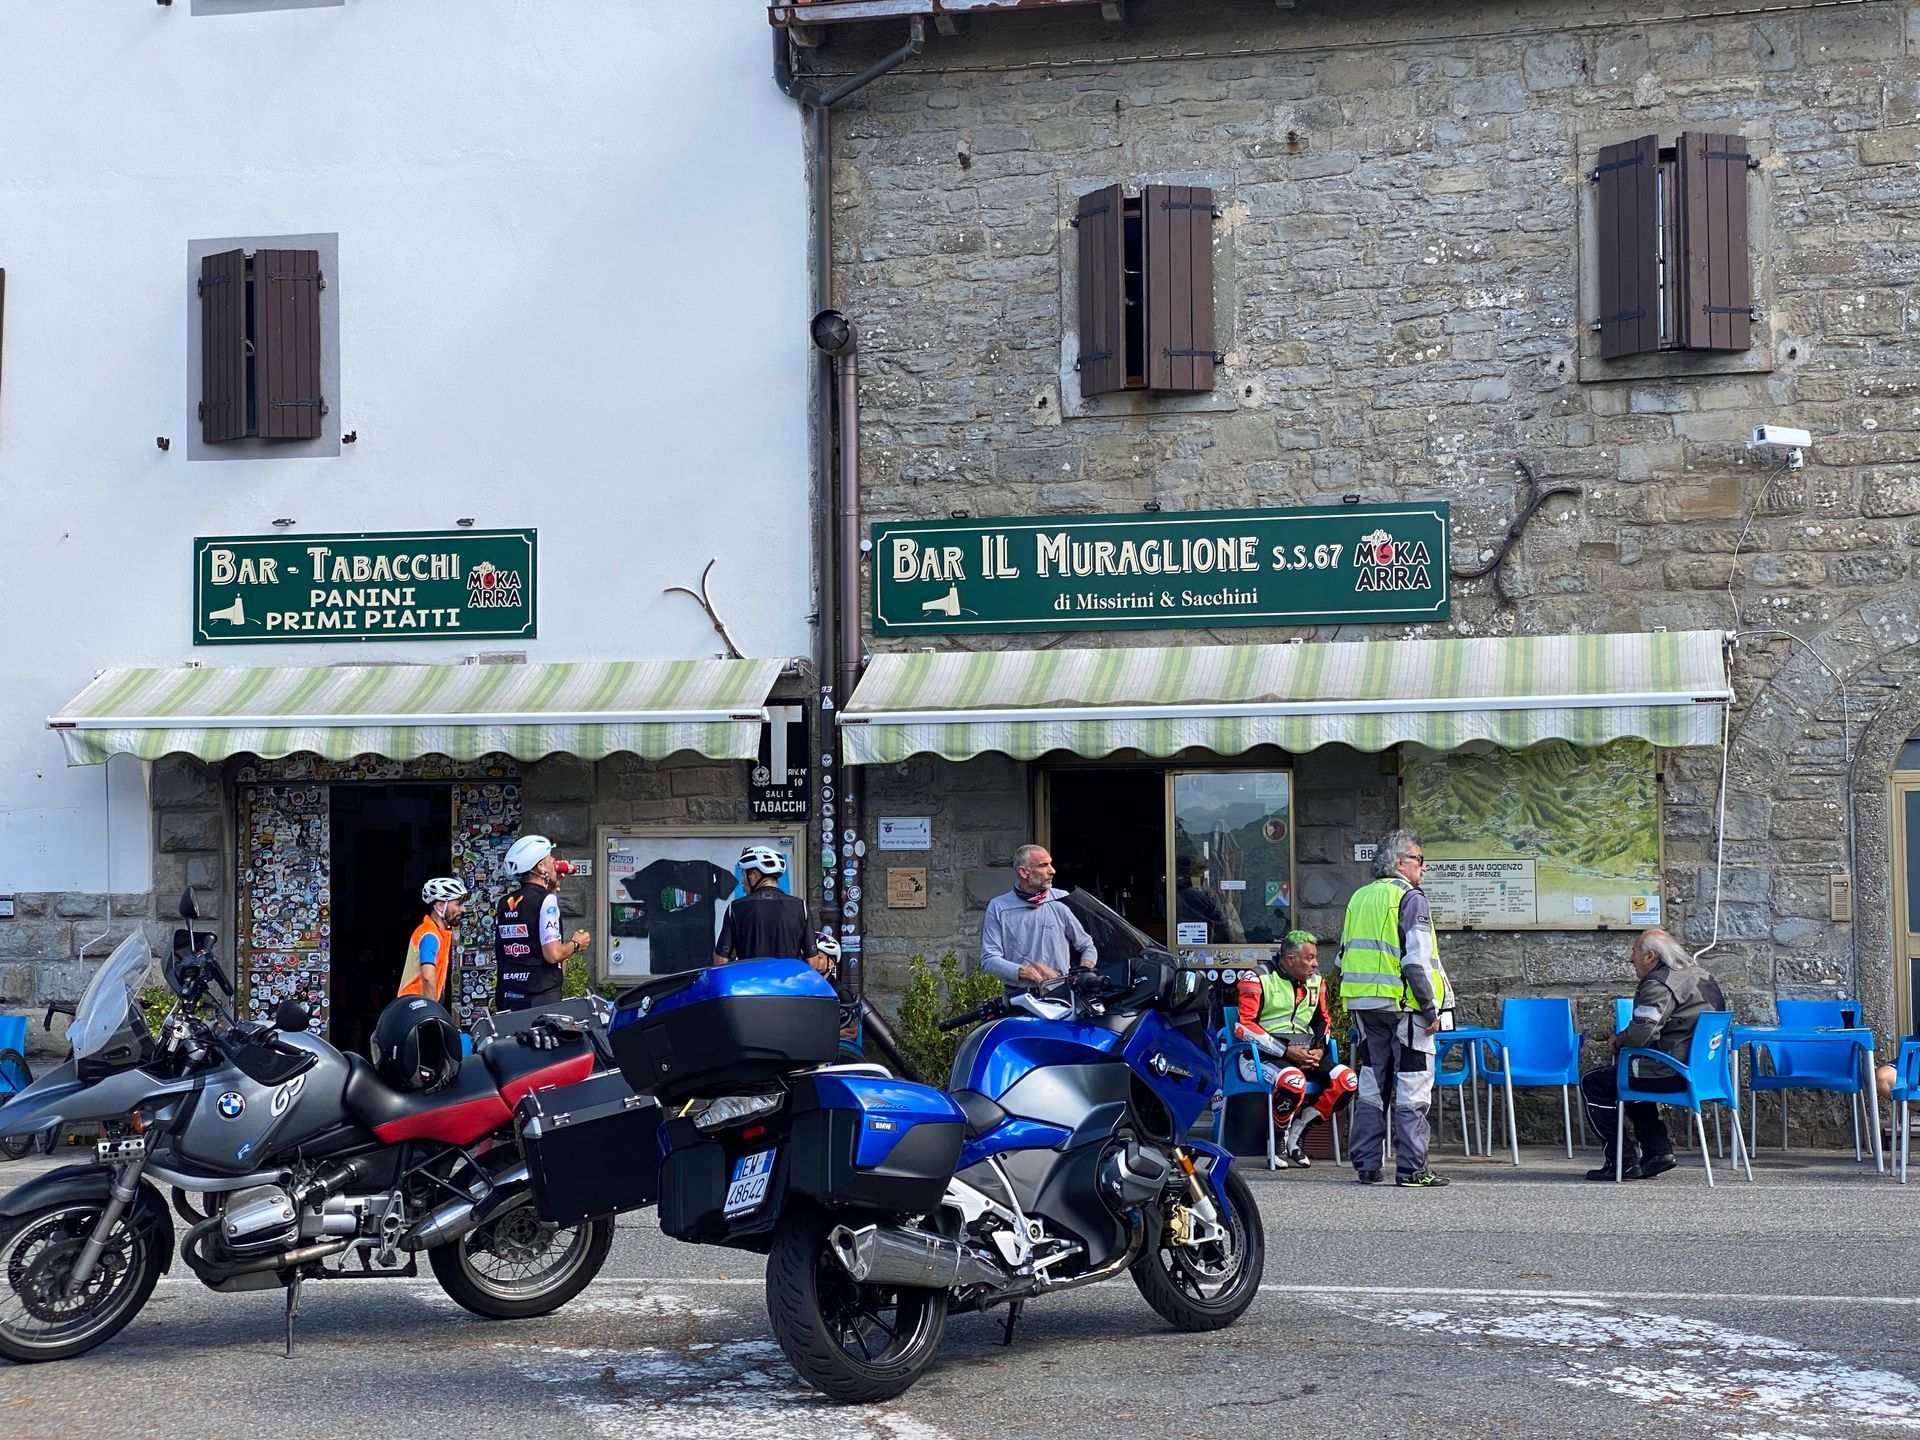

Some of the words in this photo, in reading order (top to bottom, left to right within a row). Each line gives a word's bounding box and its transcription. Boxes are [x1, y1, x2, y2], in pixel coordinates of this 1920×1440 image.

[211, 549, 279, 585] BAR
[307, 546, 460, 582] TABACCHI
[893, 538, 967, 585] BAR
[981, 534, 1020, 580] IL
[1036, 532, 1260, 578] MURAGLIONE
[1272, 543, 1344, 573] S.S.67
[1355, 565, 1432, 592] ARRA
[310, 587, 416, 608] PANINI
[468, 588, 522, 608] ARRA
[1053, 591, 1072, 611] di
[1076, 589, 1156, 610] Missirini
[1159, 590, 1176, 608] &
[1180, 587, 1259, 607] Sacchini
[266, 610, 358, 631] PRIMI
[364, 608, 462, 629] PIATTI
[762, 705, 802, 785] T
[766, 790, 784, 798] SALI
[788, 790, 793, 798] E
[794, 778, 803, 787] 10
[753, 801, 806, 812] TABACCHI
[610, 856, 633, 864] CHIUSO
[876, 1122, 892, 1130] BMW
[742, 1154, 760, 1177] EW
[727, 1178, 764, 1206] 48642
